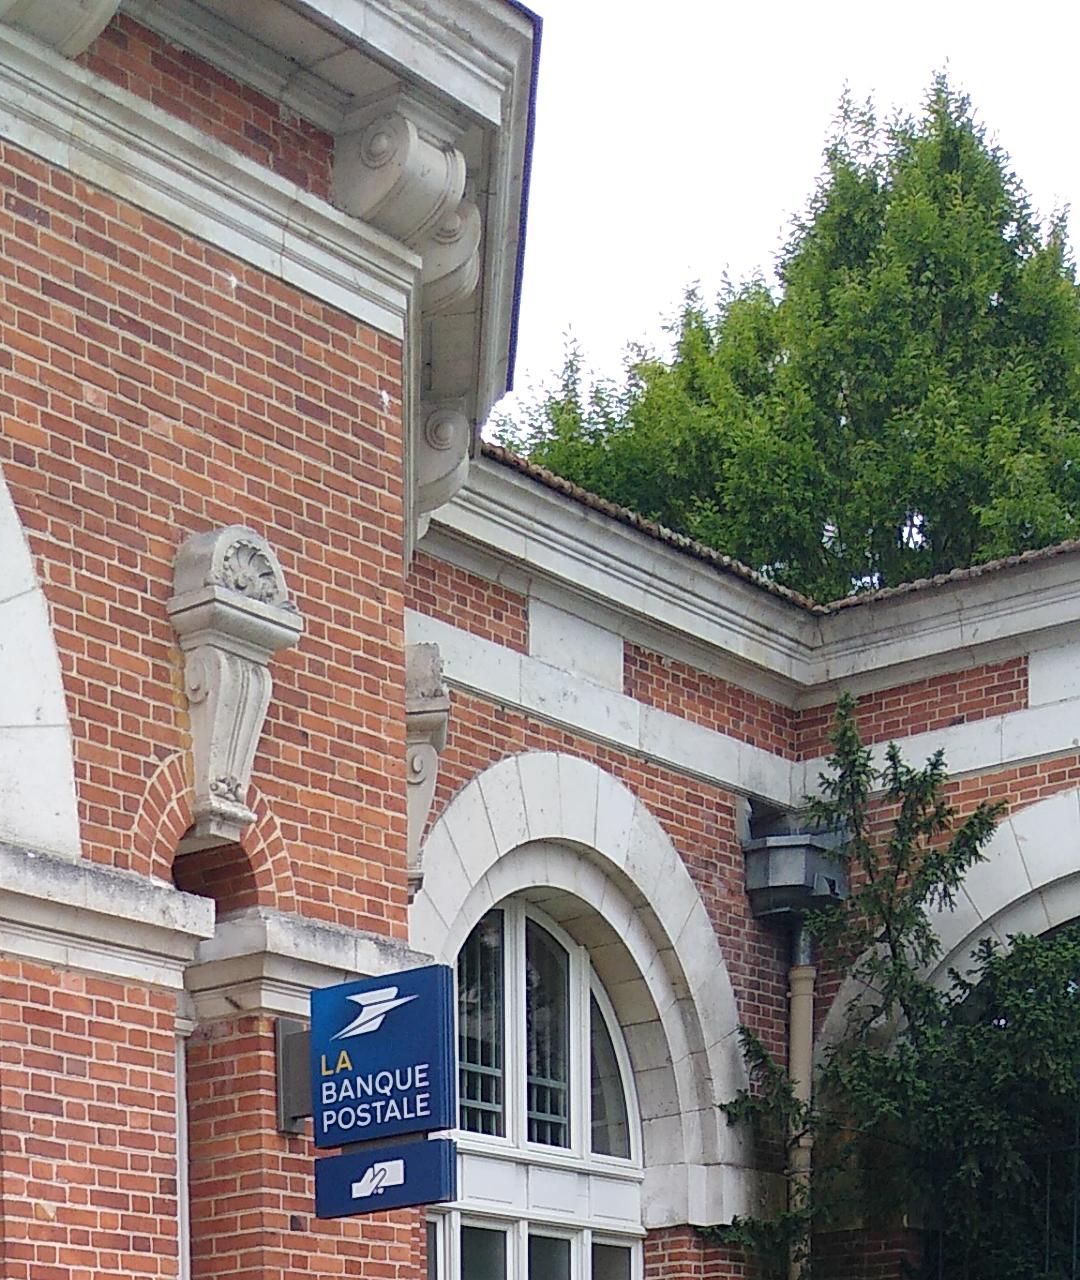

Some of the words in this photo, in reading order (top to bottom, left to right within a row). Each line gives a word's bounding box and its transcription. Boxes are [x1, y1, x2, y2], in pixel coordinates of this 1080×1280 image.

[321, 1050, 352, 1076] LA
[321, 1063, 430, 1105] BANQUE
[322, 1092, 431, 1133] POSTALE
